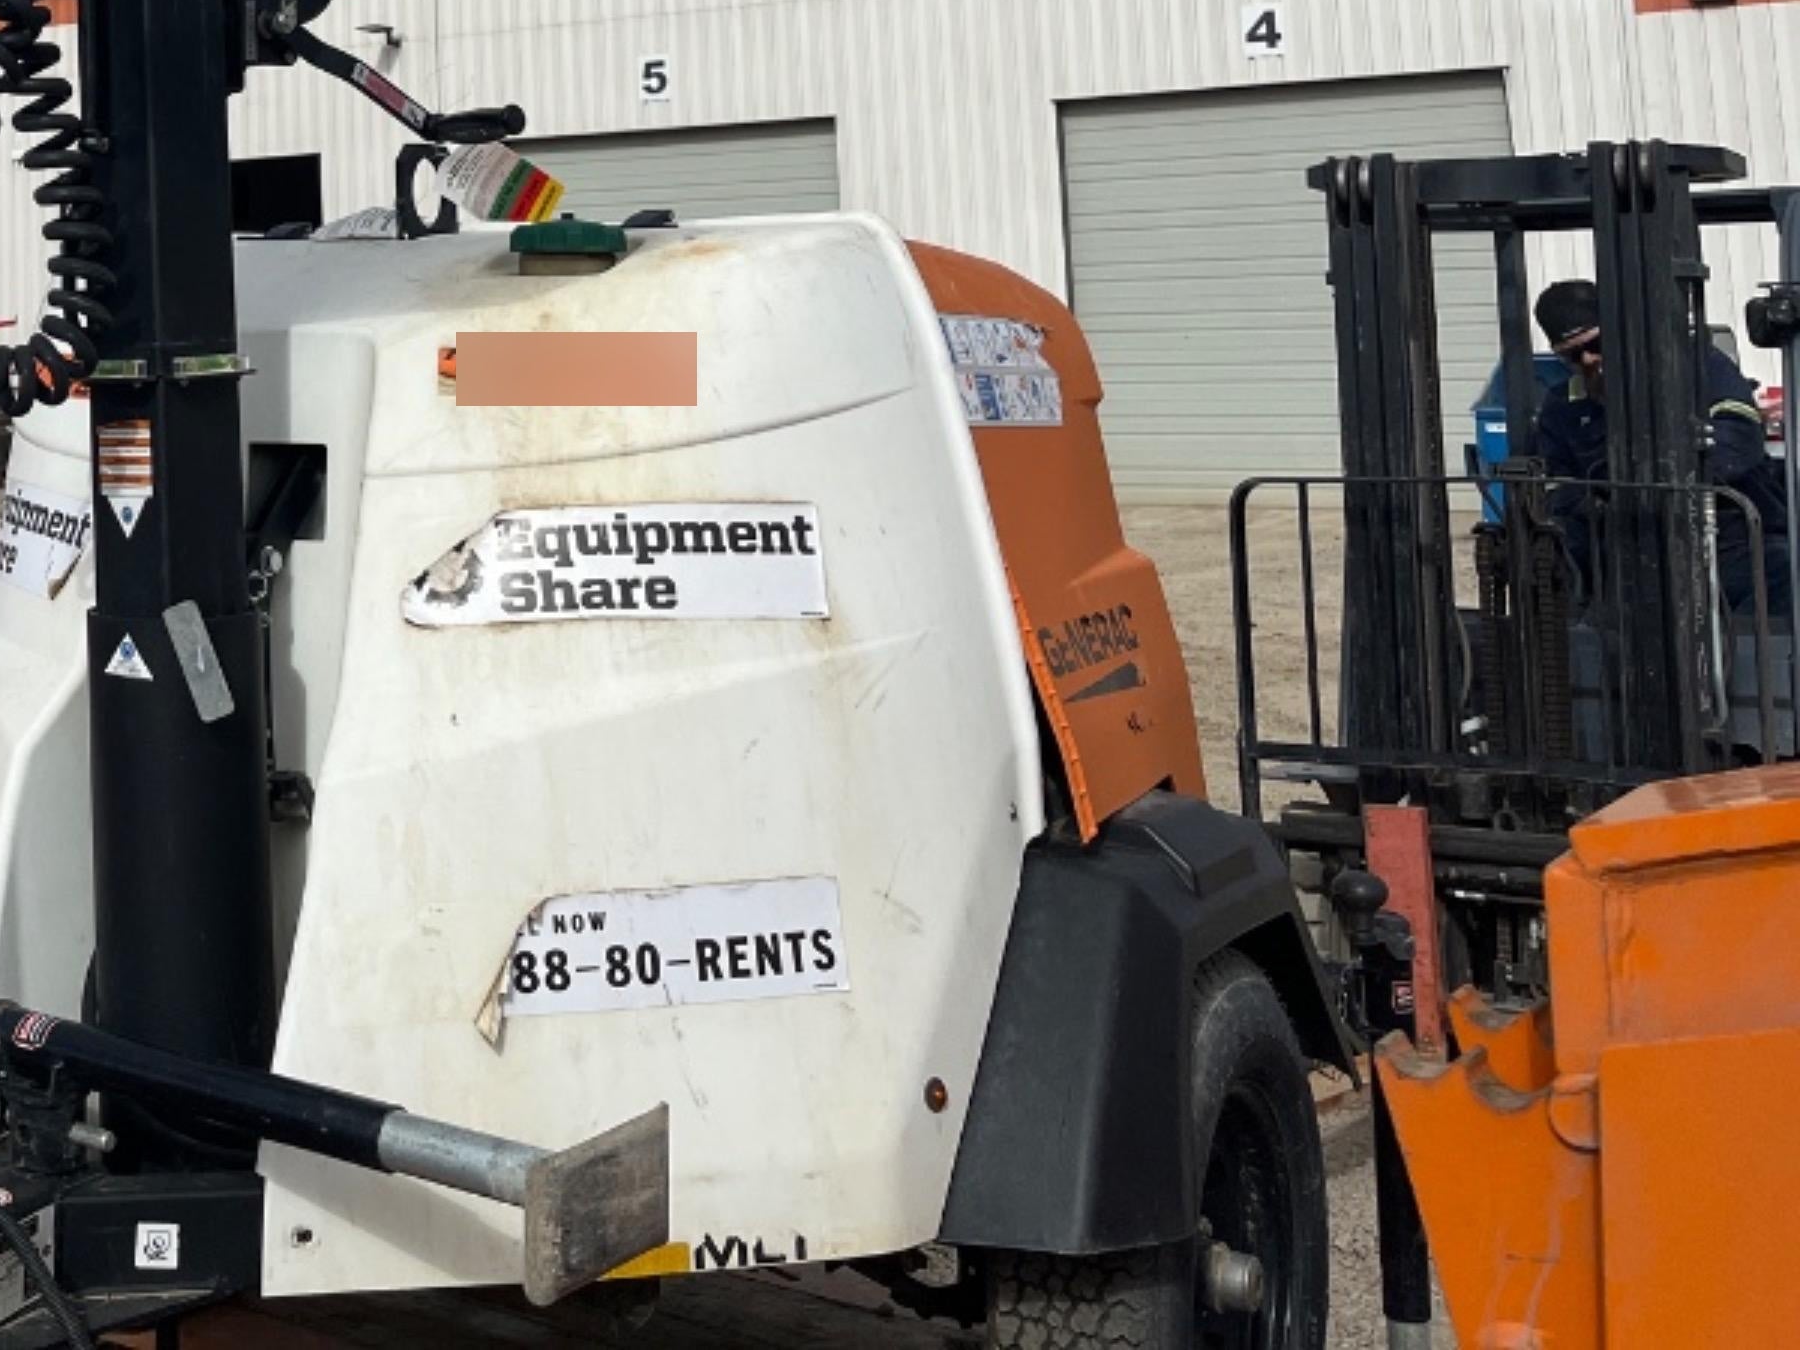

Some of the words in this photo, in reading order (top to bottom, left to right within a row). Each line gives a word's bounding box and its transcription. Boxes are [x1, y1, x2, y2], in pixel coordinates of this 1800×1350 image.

[1244, 9, 1282, 49] 4
[642, 59, 667, 94] 5
[495, 512, 817, 568] Equipment
[499, 569, 678, 613] Share
[551, 911, 607, 935] NOW
[512, 928, 836, 994] 88-80-RENTS
